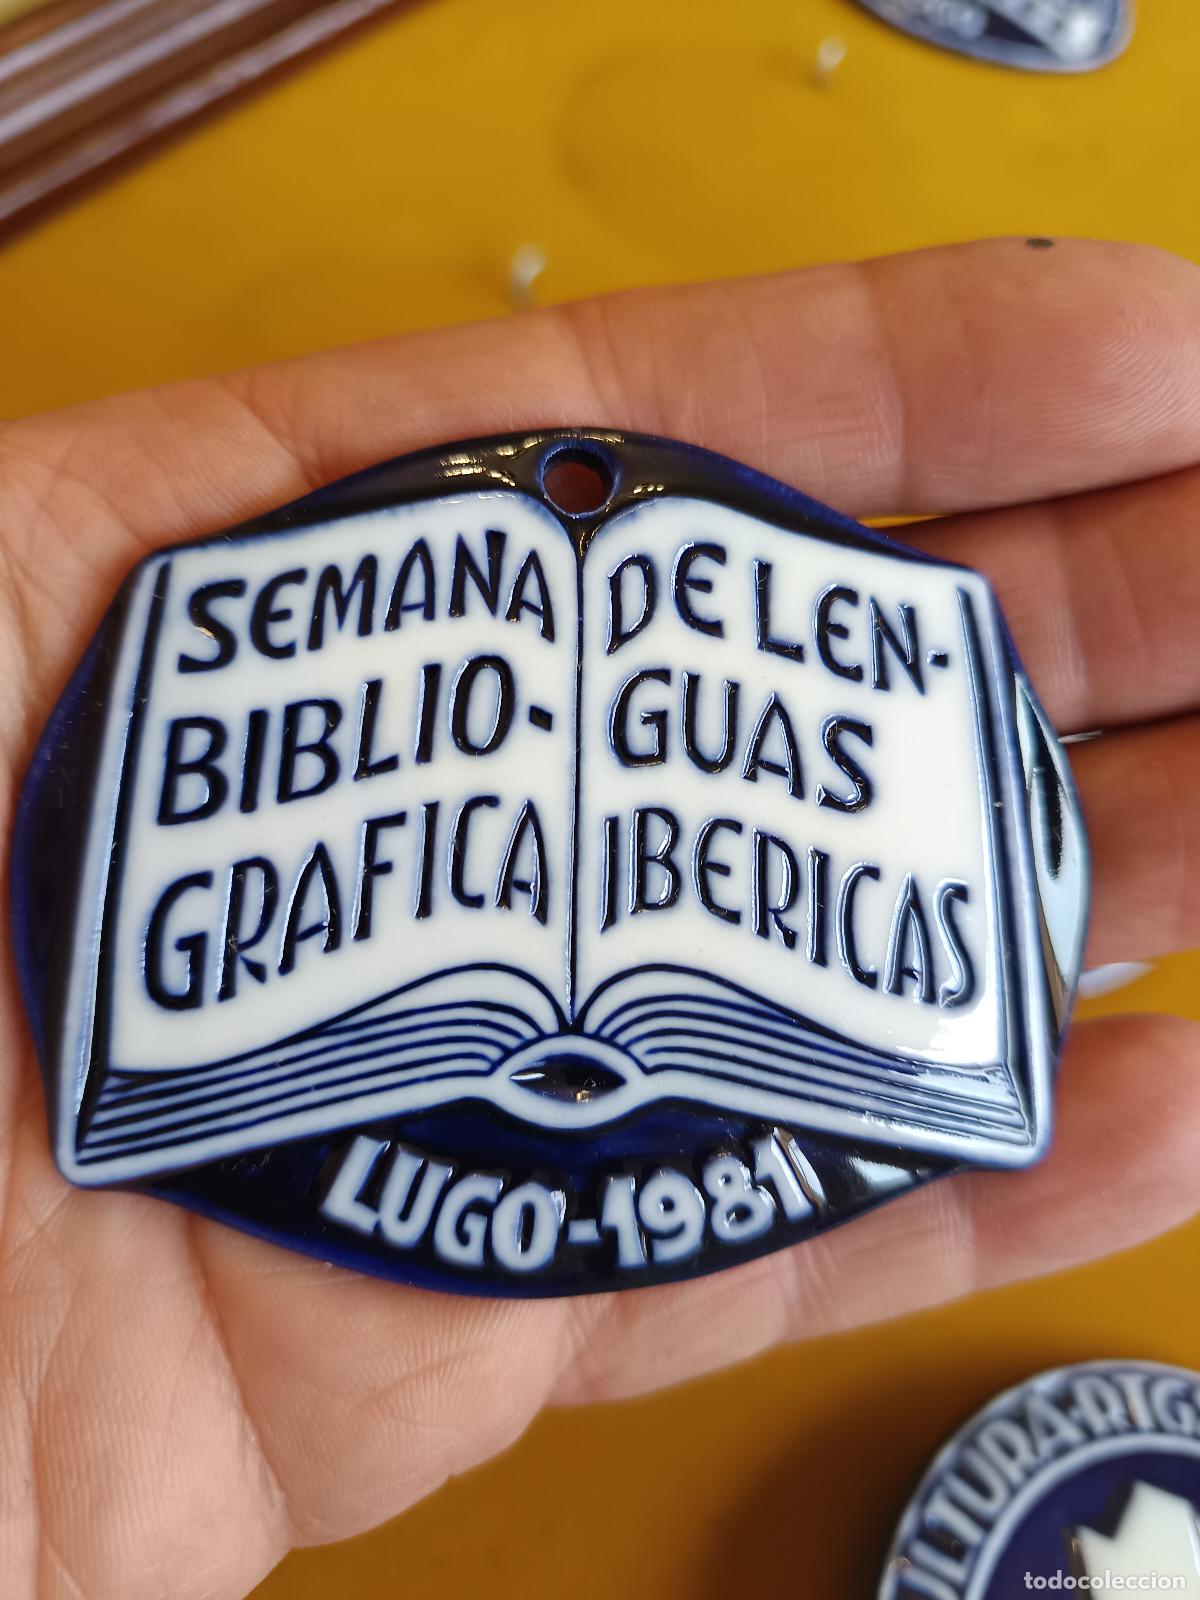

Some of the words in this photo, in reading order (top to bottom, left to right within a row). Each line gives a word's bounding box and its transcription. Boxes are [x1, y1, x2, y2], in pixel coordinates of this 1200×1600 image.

[177, 529, 555, 674] SEMANA
[605, 541, 727, 656] DE
[751, 558, 949, 696] LEN-
[156, 654, 553, 826] BIBLIO-
[608, 668, 875, 814] GUAS
[142, 795, 549, 1012] GRAFICA
[600, 806, 976, 1009] IBERICAS
